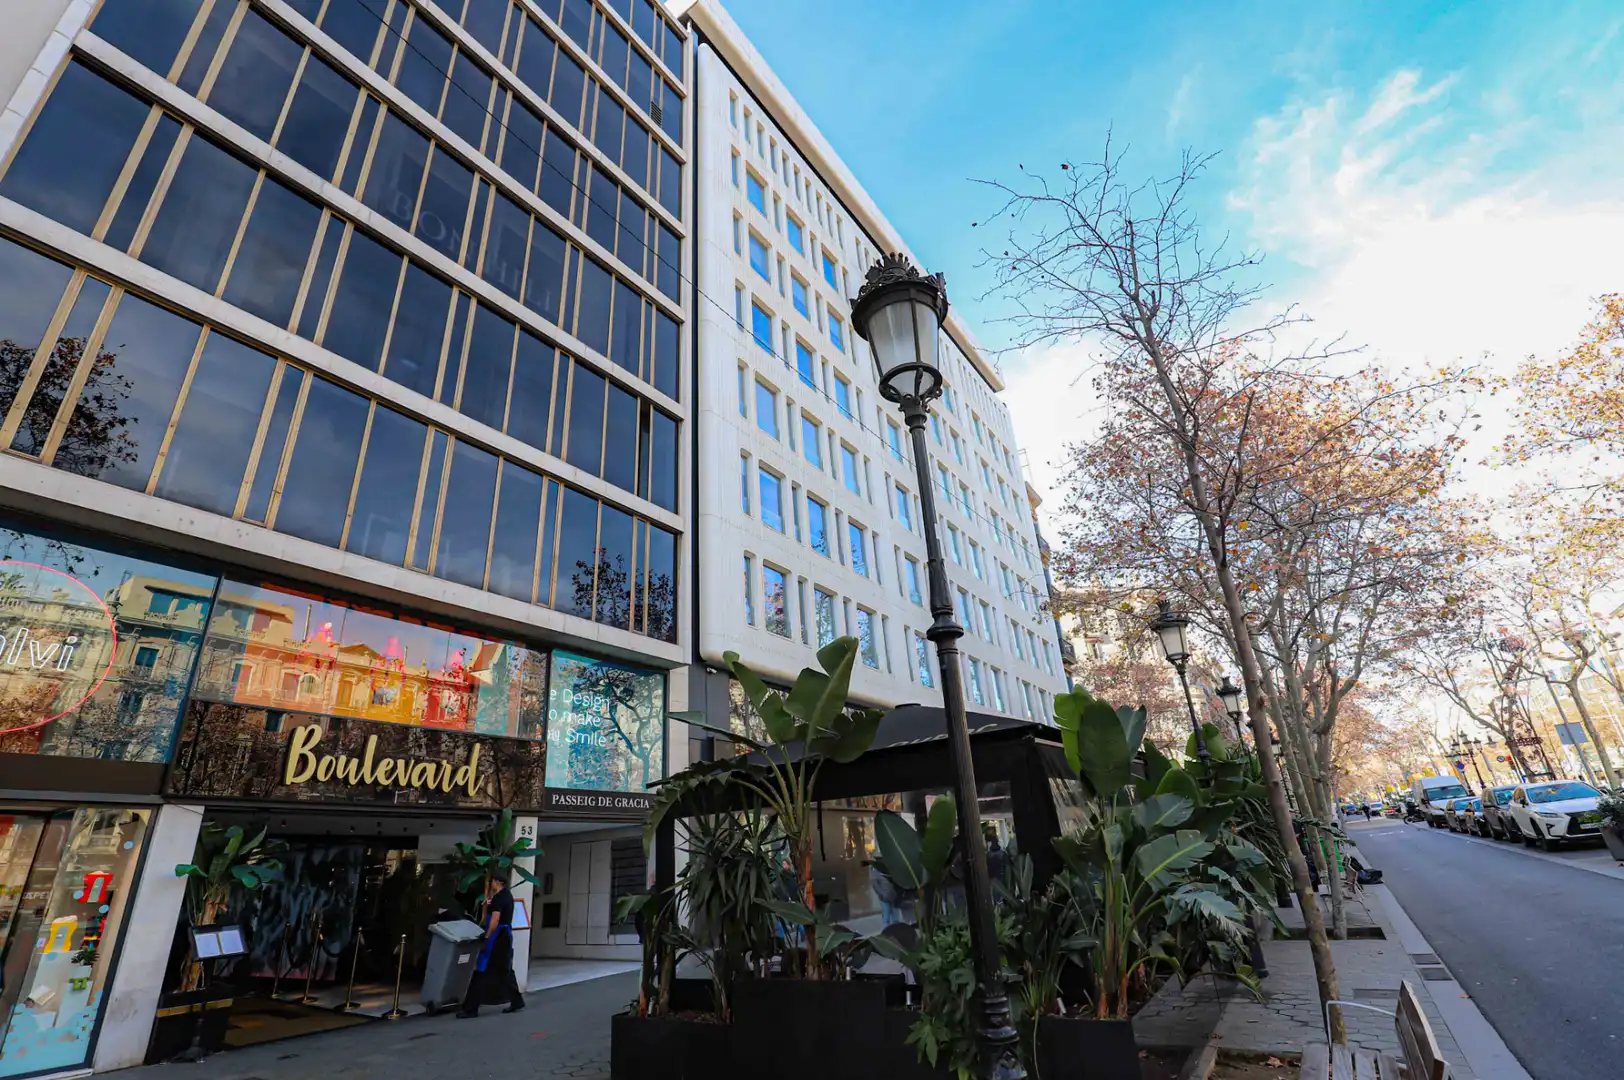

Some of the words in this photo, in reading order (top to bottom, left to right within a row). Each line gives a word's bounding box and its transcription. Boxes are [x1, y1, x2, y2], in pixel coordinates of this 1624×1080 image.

[0, 627, 78, 672] lvi
[563, 688, 610, 712] Design
[563, 710, 601, 727] make
[565, 728, 607, 748] Smile
[285, 724, 485, 797] Boulevard
[552, 794, 596, 807] PASSEIG
[598, 796, 612, 808] DE
[614, 797, 650, 809] GRACIA
[521, 825, 533, 836] 53
